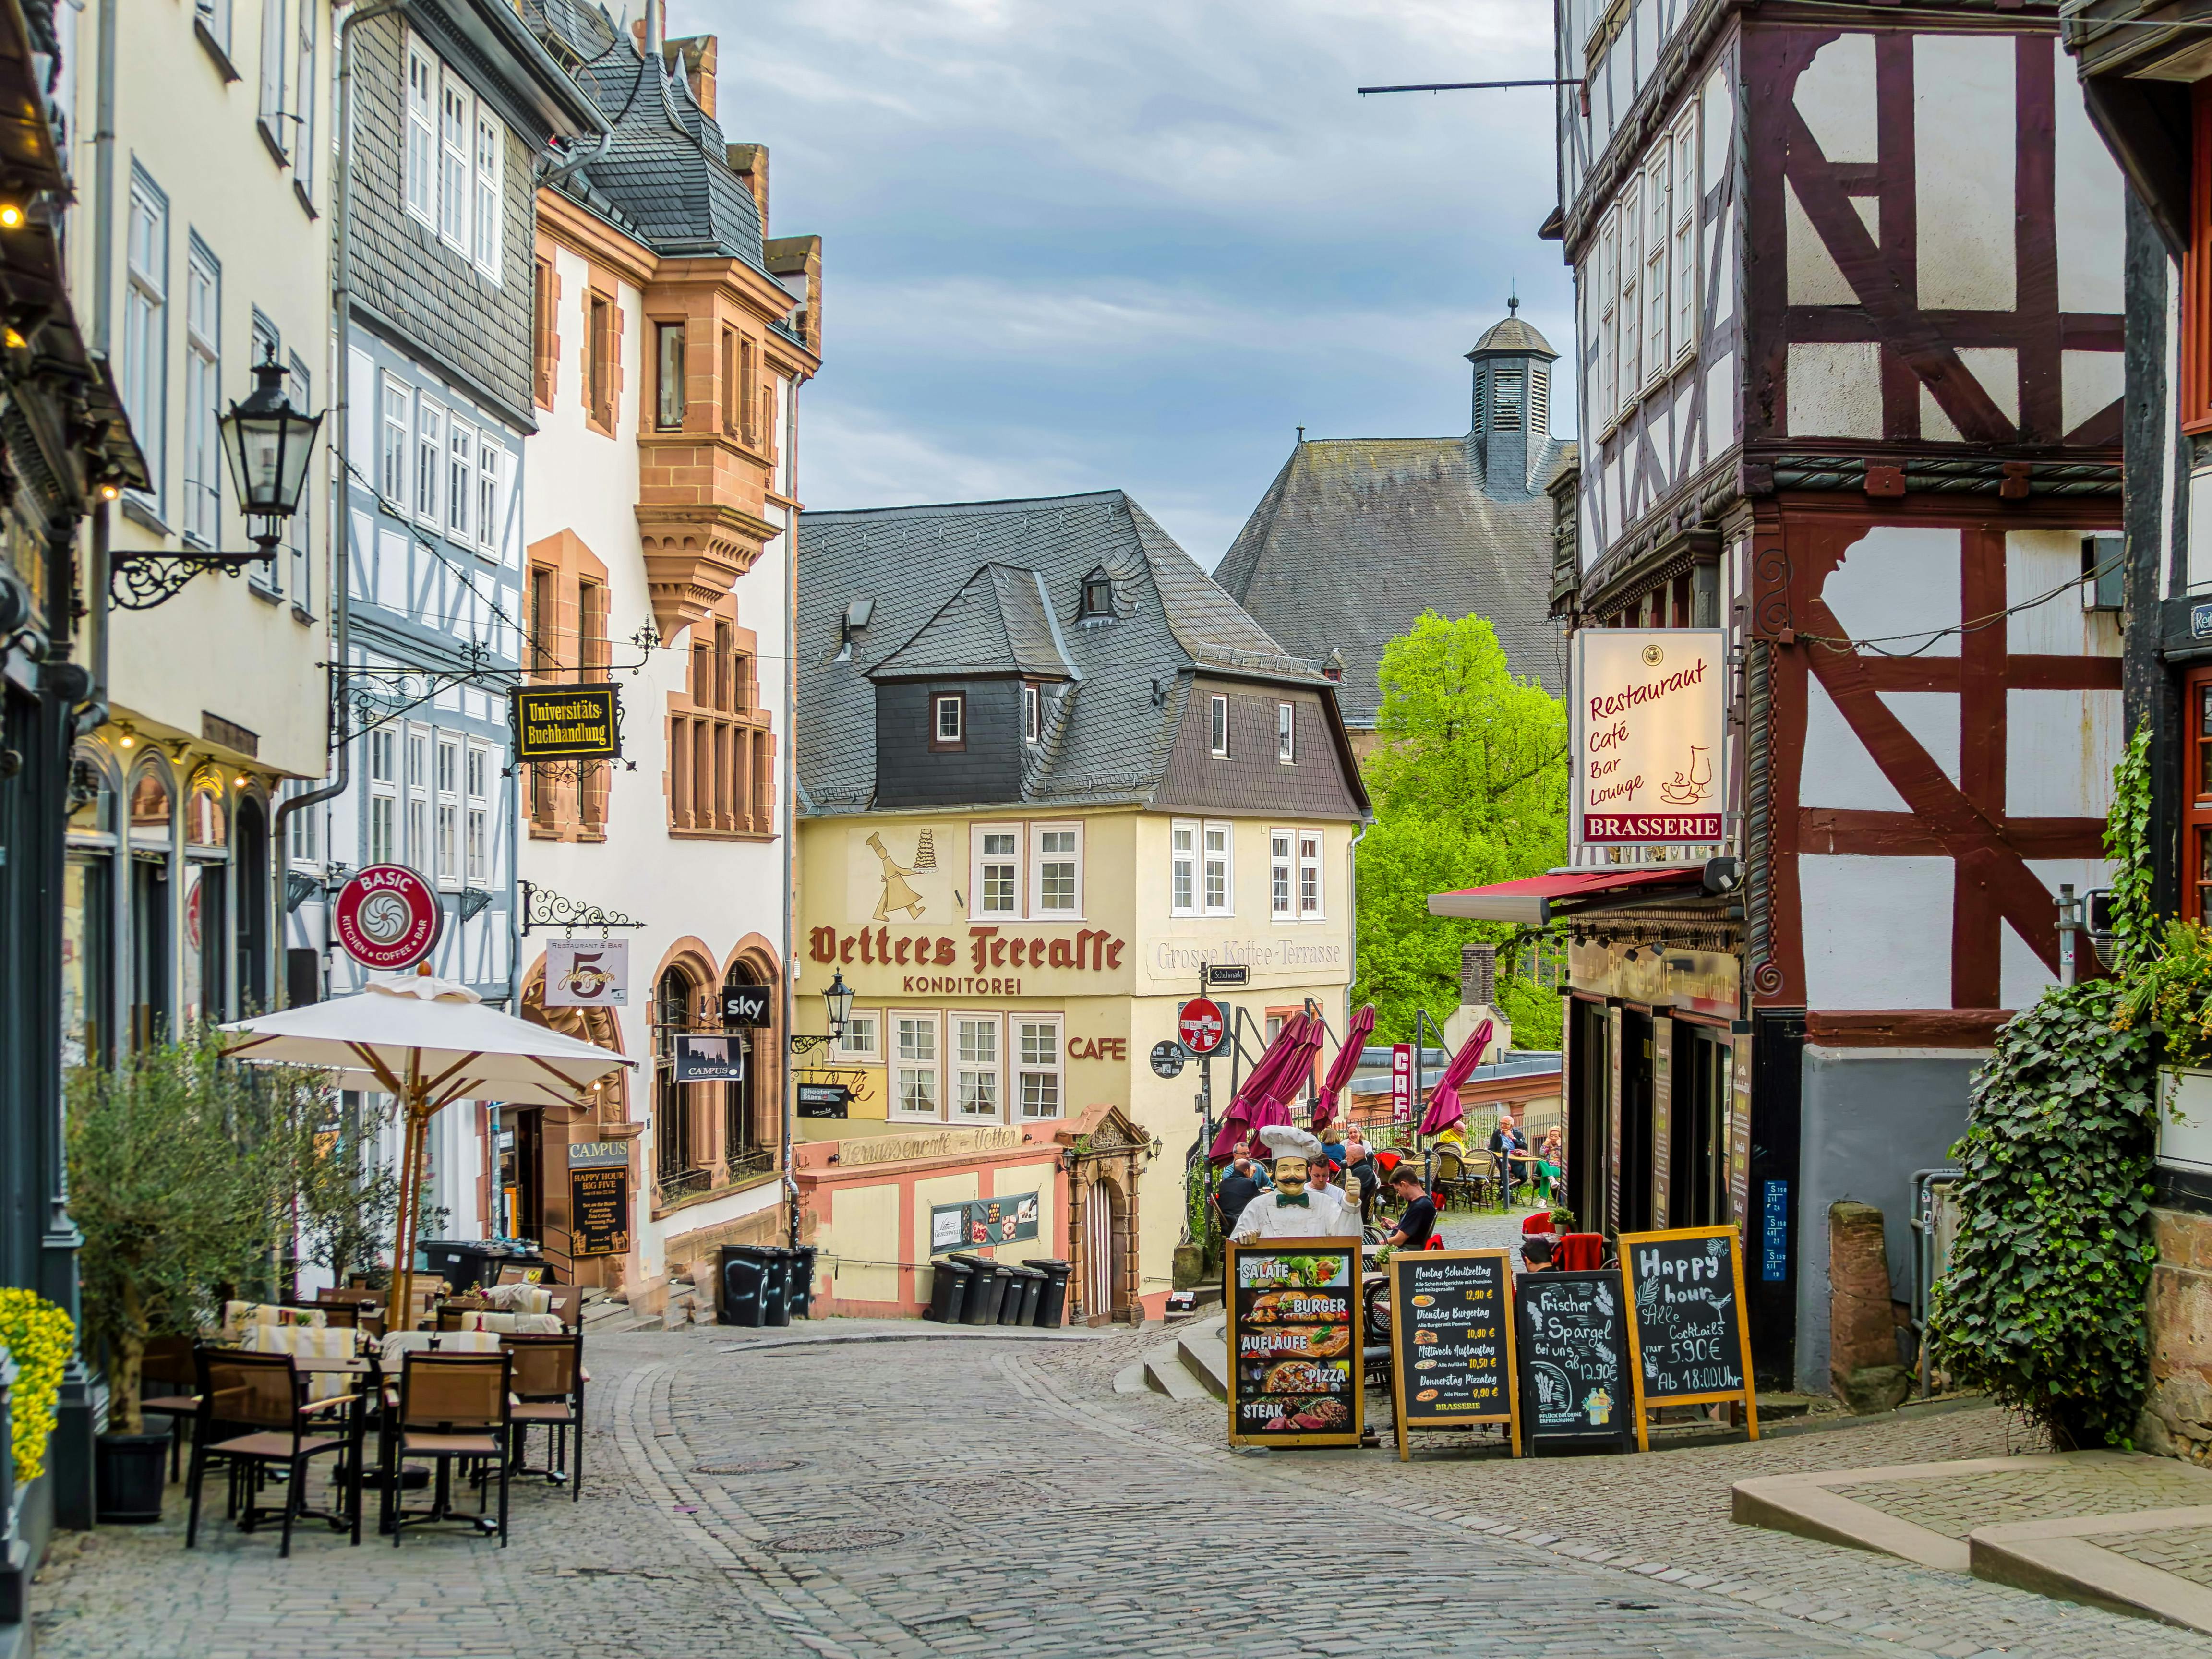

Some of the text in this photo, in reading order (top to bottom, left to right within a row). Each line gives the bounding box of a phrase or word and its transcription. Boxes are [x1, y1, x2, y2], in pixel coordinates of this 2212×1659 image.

[1590, 658, 1707, 721] Restaurant
[528, 723, 606, 745] Buchhandlung
[1590, 720, 1629, 752] Café
[1590, 757, 1621, 779] Bar
[1590, 775, 1645, 806] Lounge
[1588, 818, 1719, 836] BRASSERIE
[360, 871, 413, 892] BASIC
[342, 915, 428, 961] KITCHEN COFFEE BAR
[809, 926, 956, 966] Vetters
[1157, 943, 1218, 969] Grosse
[571, 952, 606, 998] 5
[1214, 971, 1243, 979] Schuhmarkt
[903, 976, 1021, 995] KONDITOREI
[727, 995, 764, 1019] sky
[1068, 1037, 1126, 1060] CAFE
[688, 1067, 728, 1075] CAMPUS
[975, 1128, 1016, 1150] Vetter
[570, 1142, 627, 1158] CAMPUS
[574, 1172, 624, 1182] HAPPY HOUR
[1770, 1218, 1775, 1226] S
[1242, 1264, 1289, 1278] SALATE
[1416, 1265, 1491, 1280] Montag Schnitzeltag
[1466, 1289, 1493, 1301] 12,90 €
[1665, 1283, 1713, 1304] hour
[1294, 1298, 1346, 1313] BURGER
[1541, 1292, 1592, 1313] Frischer
[1417, 1307, 1490, 1320] Dienstag Burgertag
[1642, 1303, 1681, 1325] Alle
[1467, 1327, 1495, 1339] 10,90 €
[1548, 1317, 1611, 1347] Spargel
[1669, 1322, 1725, 1340] Cocktails
[1242, 1333, 1307, 1350] AUFLÄUFE
[1646, 1345, 1665, 1353] nur
[1419, 1344, 1495, 1358] Mittwoch Auflauftag
[1552, 1346, 1574, 1358] uns
[1469, 1358, 1488, 1370] 10,50
[1490, 1357, 1497, 1368] €
[1565, 1354, 1580, 1370] ab
[1309, 1369, 1346, 1382] PIZZA
[1420, 1373, 1497, 1386] Donnerstag Pizzatag
[1658, 1372, 1678, 1390] Ab
[1473, 1388, 1490, 1399] 8,90
[1491, 1387, 1498, 1397] €
[1244, 1404, 1283, 1419] STEAK
[1436, 1402, 1480, 1410] BRASSERIE
